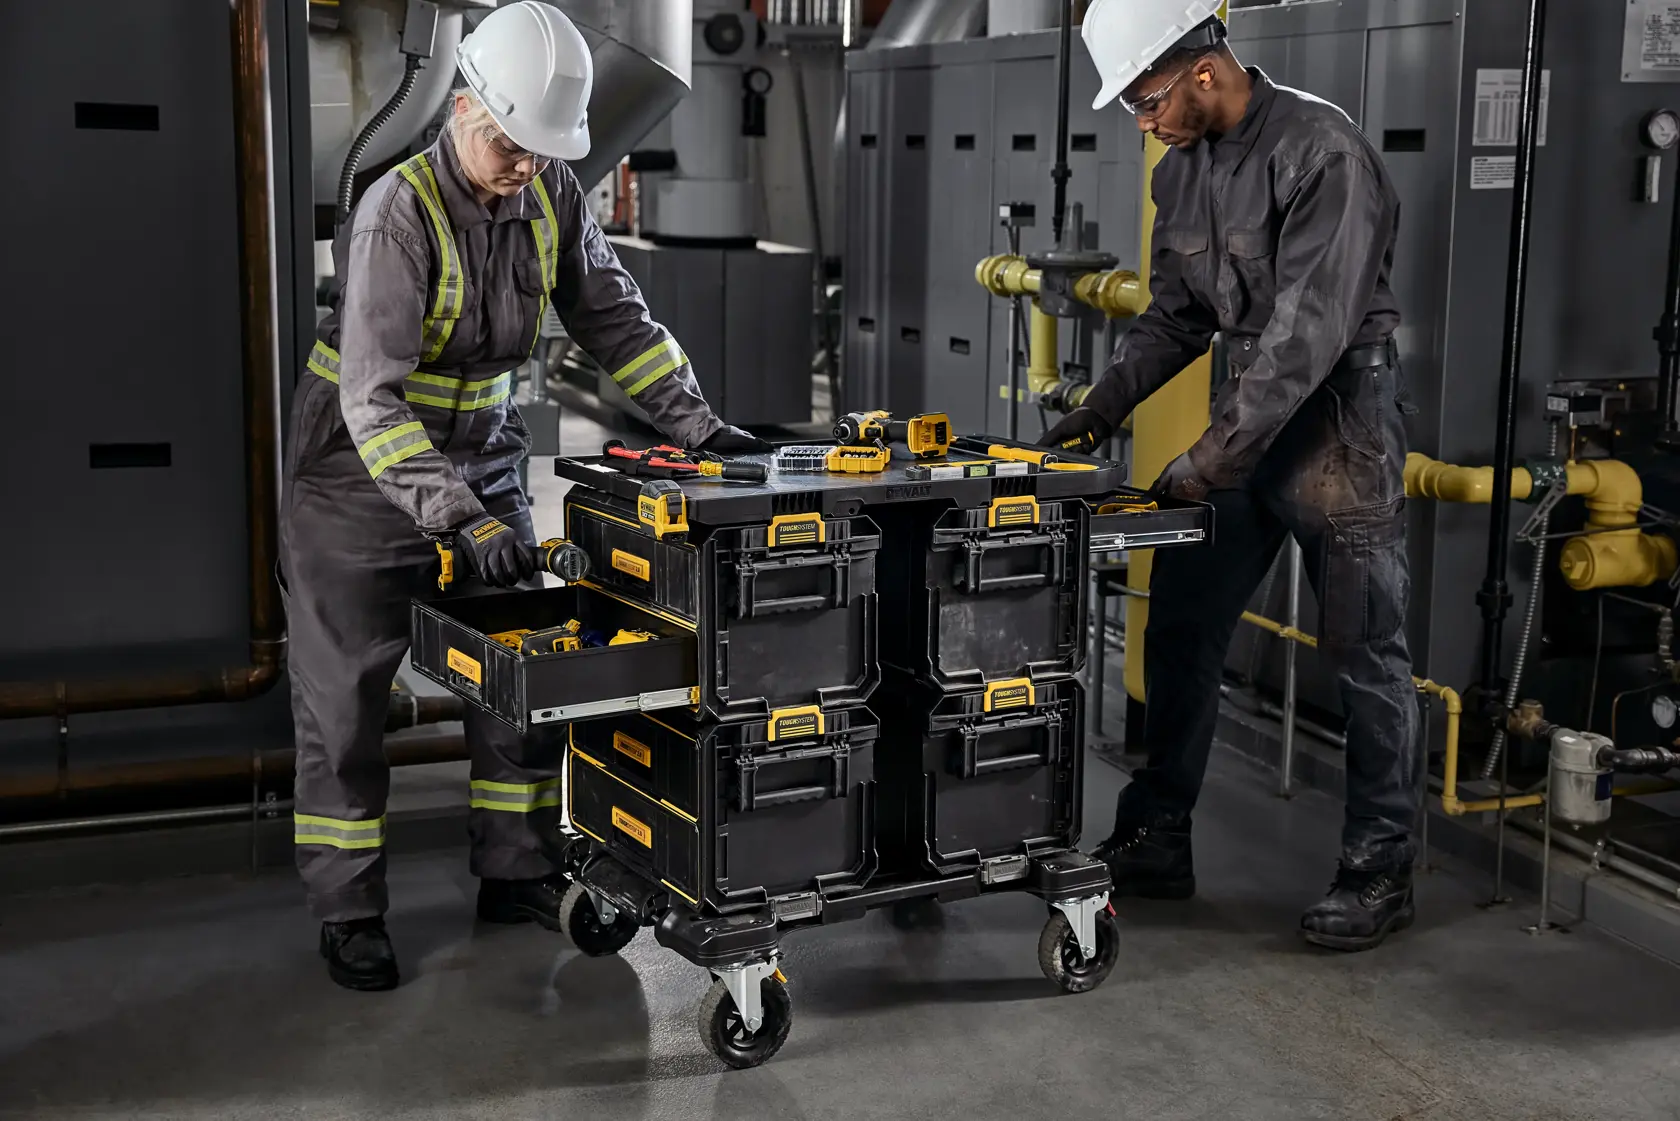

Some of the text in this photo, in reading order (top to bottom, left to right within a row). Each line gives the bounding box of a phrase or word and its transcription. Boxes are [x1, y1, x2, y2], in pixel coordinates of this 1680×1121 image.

[885, 484, 931, 500] DEWALT
[999, 505, 1031, 513] TOUGHSYSTEM
[780, 523, 816, 532] TOUGHSYSTEM
[994, 688, 1026, 698] TOUGHSYSTEM
[779, 716, 815, 727] TOUGHSYSTEM
